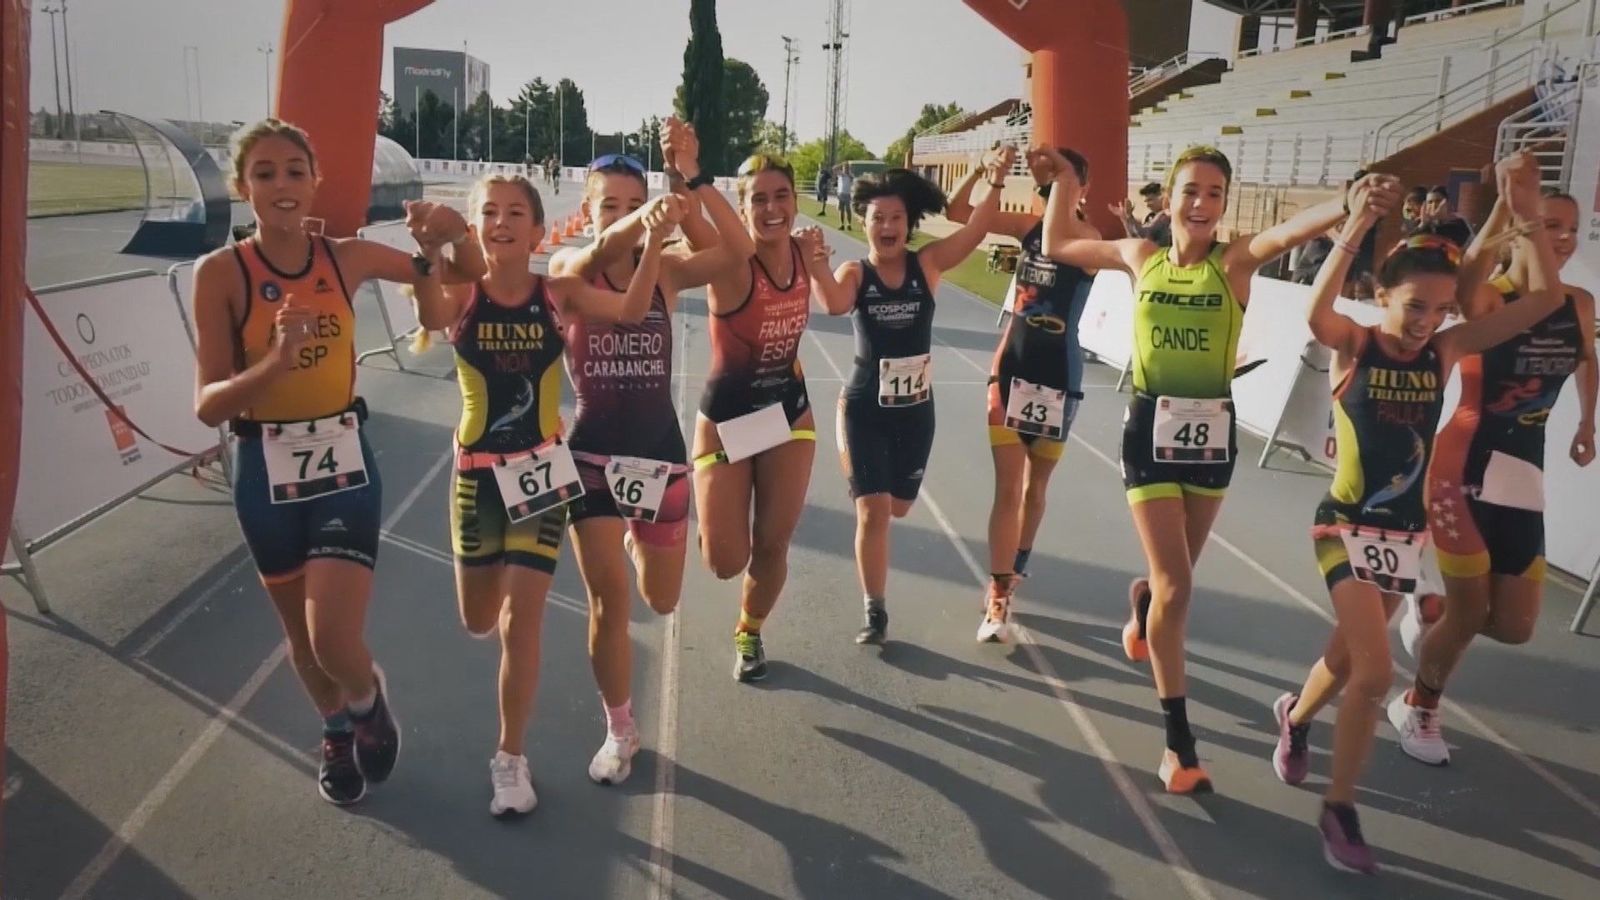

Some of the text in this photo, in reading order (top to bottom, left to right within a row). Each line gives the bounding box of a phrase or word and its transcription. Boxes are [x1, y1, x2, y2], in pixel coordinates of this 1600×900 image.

[868, 302, 920, 314] ECOSPORT
[477, 322, 544, 340] HUNO
[1150, 325, 1210, 352] CANDE
[477, 340, 544, 351] TRIATLON
[588, 333, 663, 356] ROMERO
[761, 342, 794, 363] ESP
[288, 344, 328, 371] SP
[583, 360, 665, 378] CARABANCHEL
[889, 379, 924, 396] 114
[1367, 366, 1437, 389] HUNO
[1366, 387, 1437, 402] TRIATLON
[1020, 401, 1048, 422] 43
[1173, 422, 1210, 447] 48
[292, 446, 339, 480] 74
[518, 462, 554, 496] 67
[613, 476, 645, 505] 46
[1363, 544, 1399, 574] 80
